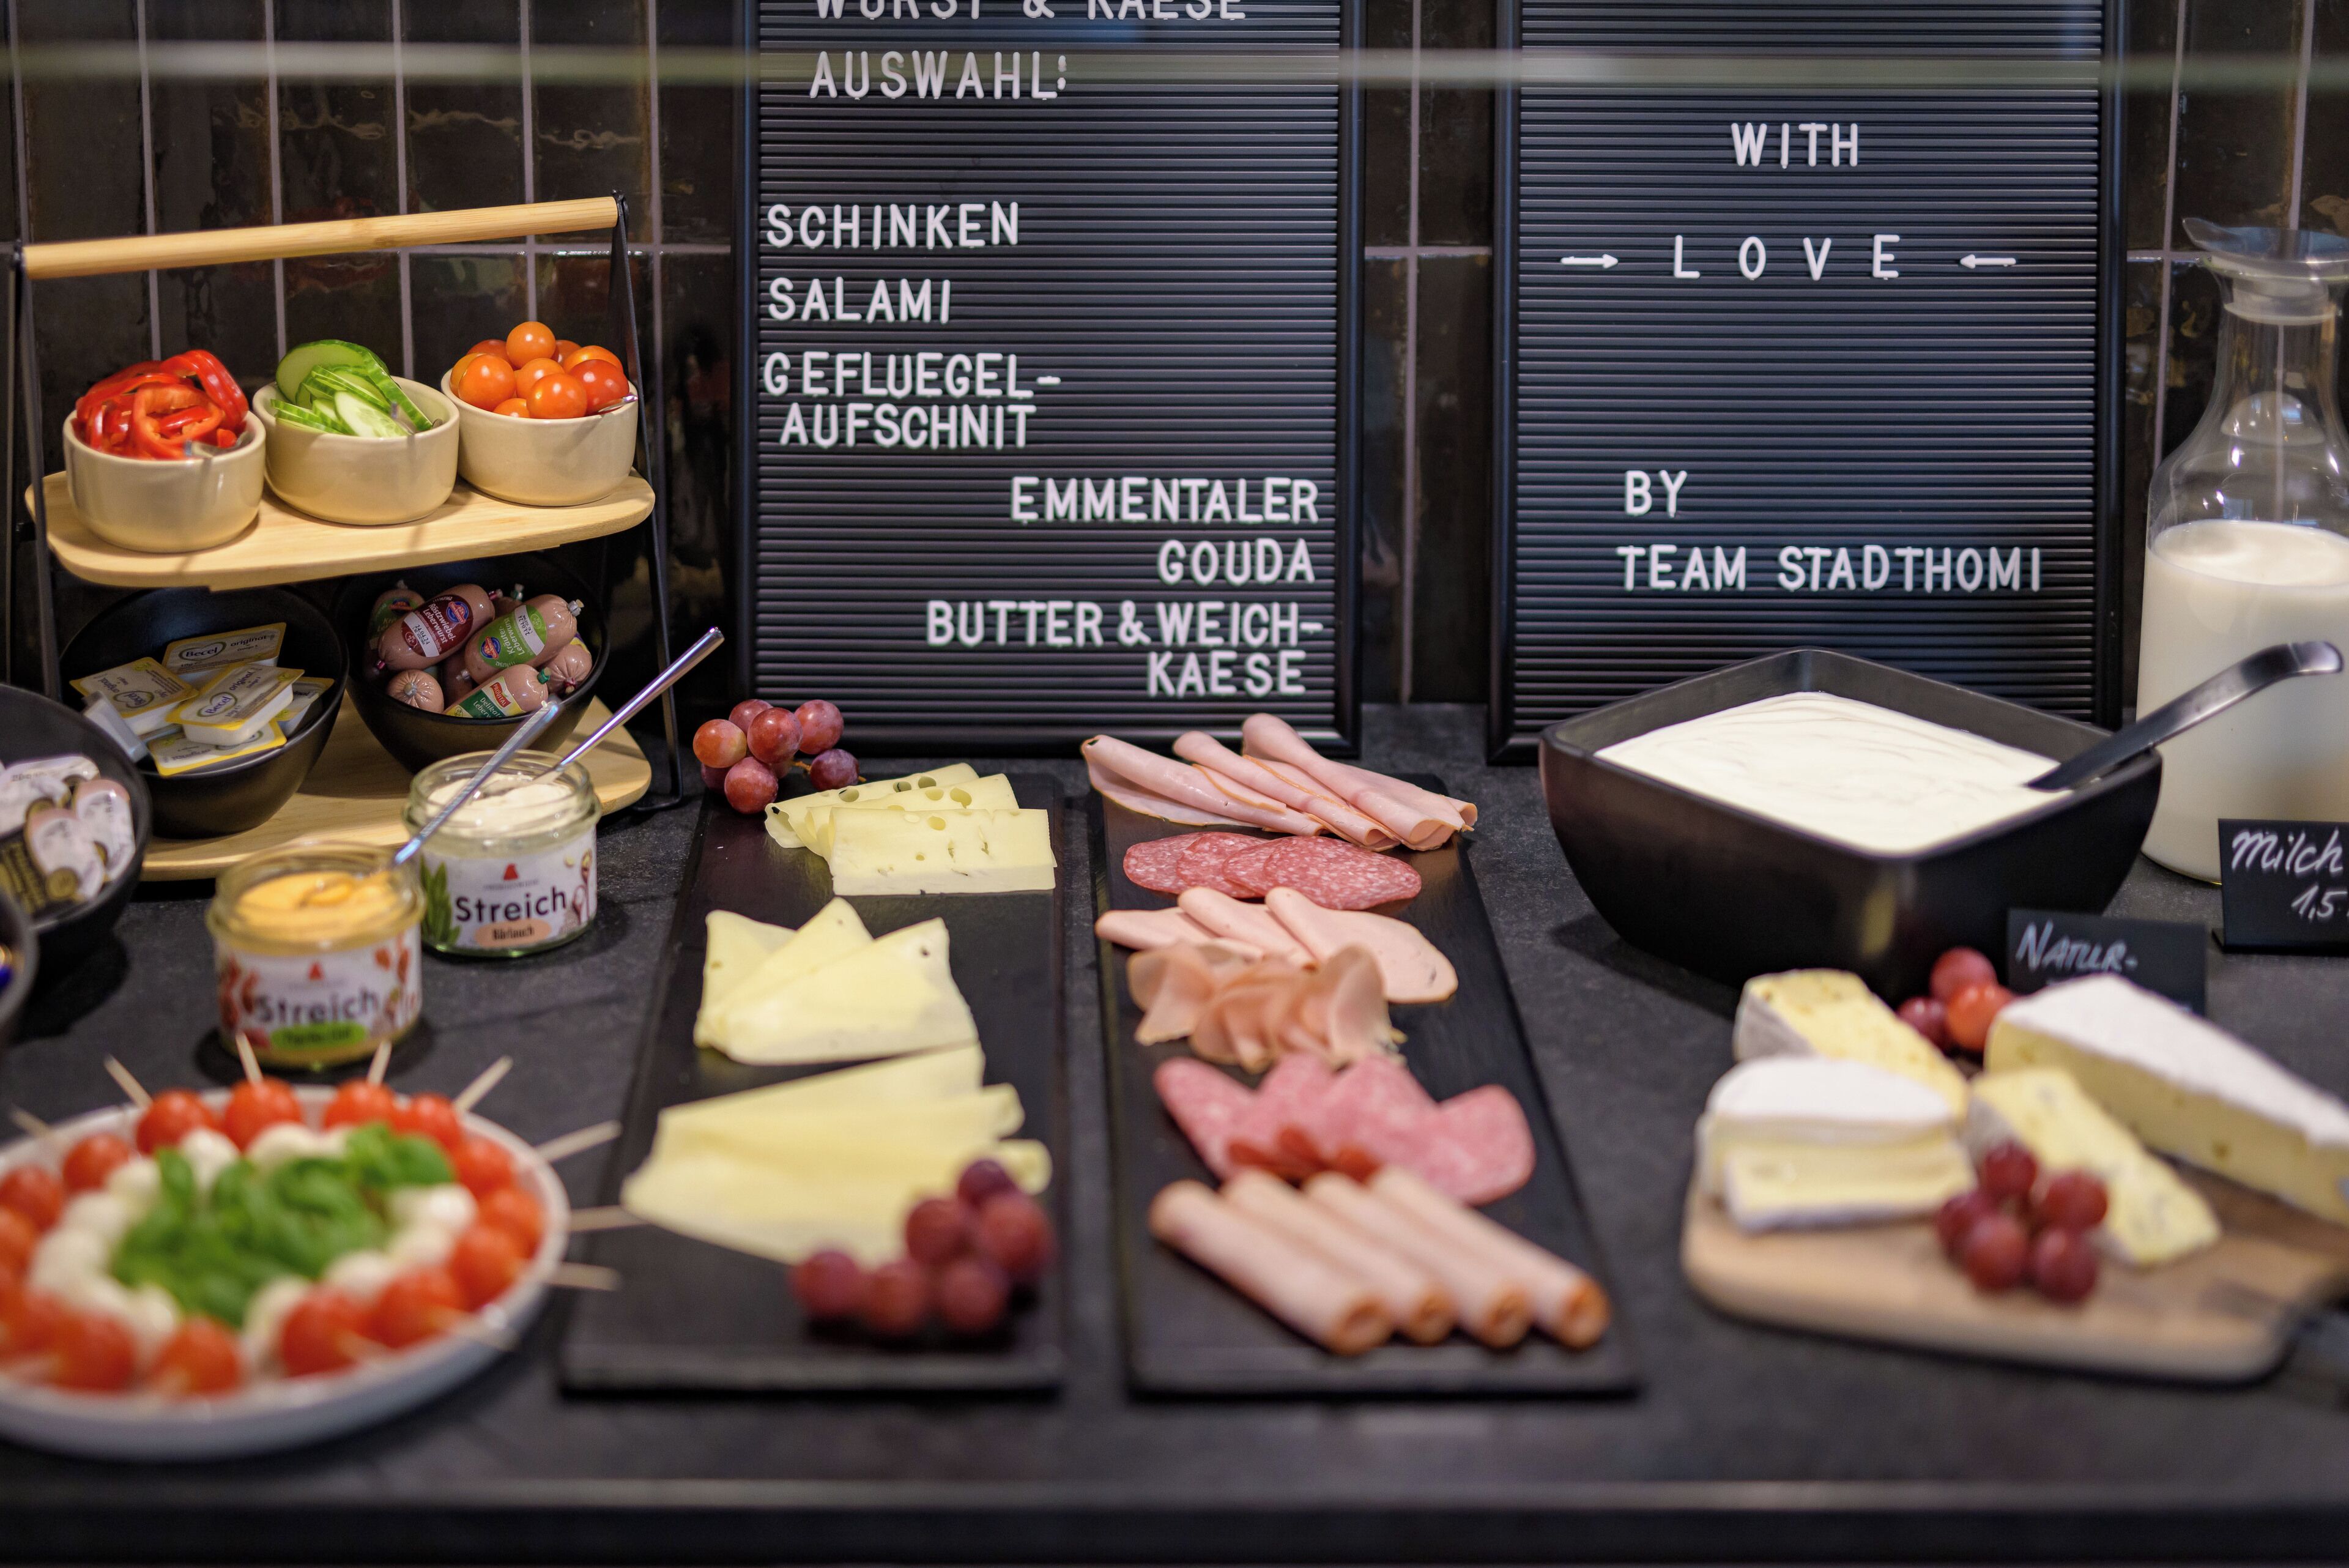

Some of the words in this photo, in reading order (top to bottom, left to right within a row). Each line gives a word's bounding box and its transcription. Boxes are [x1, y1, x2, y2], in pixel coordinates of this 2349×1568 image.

[810, 51, 1066, 100] AUSWAHL:
[1732, 122, 1858, 168] WITH
[766, 201, 1019, 250] SCHINKEN
[769, 277, 951, 324] SALAMI
[764, 351, 1061, 399] GEFLUEGEL-
[780, 403, 1036, 450] AUFSCHNIT
[1011, 477, 1318, 524] EMMENTALER
[1625, 470, 1687, 518] BY
[1157, 538, 1315, 584] GOUDA
[1617, 544, 1746, 591] TEAM
[1778, 544, 2041, 593] STADTHOMI
[415, 624, 431, 645] 24.04.24
[423, 609, 448, 644] Leberwurst
[428, 603, 456, 641] Röstzwiebel-
[499, 625, 515, 655] Kräuter-
[504, 617, 525, 655] Leberwurst
[927, 600, 1104, 647] BUTTER
[185, 647, 218, 658] Becel
[230, 634, 266, 647] original
[205, 696, 233, 714] Becel
[229, 671, 254, 691] original
[494, 683, 507, 707] PROVITAL
[1148, 650, 1306, 697] KAESE
[2232, 828, 2343, 875] Milch
[456, 885, 566, 922] Streich
[2291, 884, 2348, 921] 1,5
[254, 986, 379, 1024] Streich
